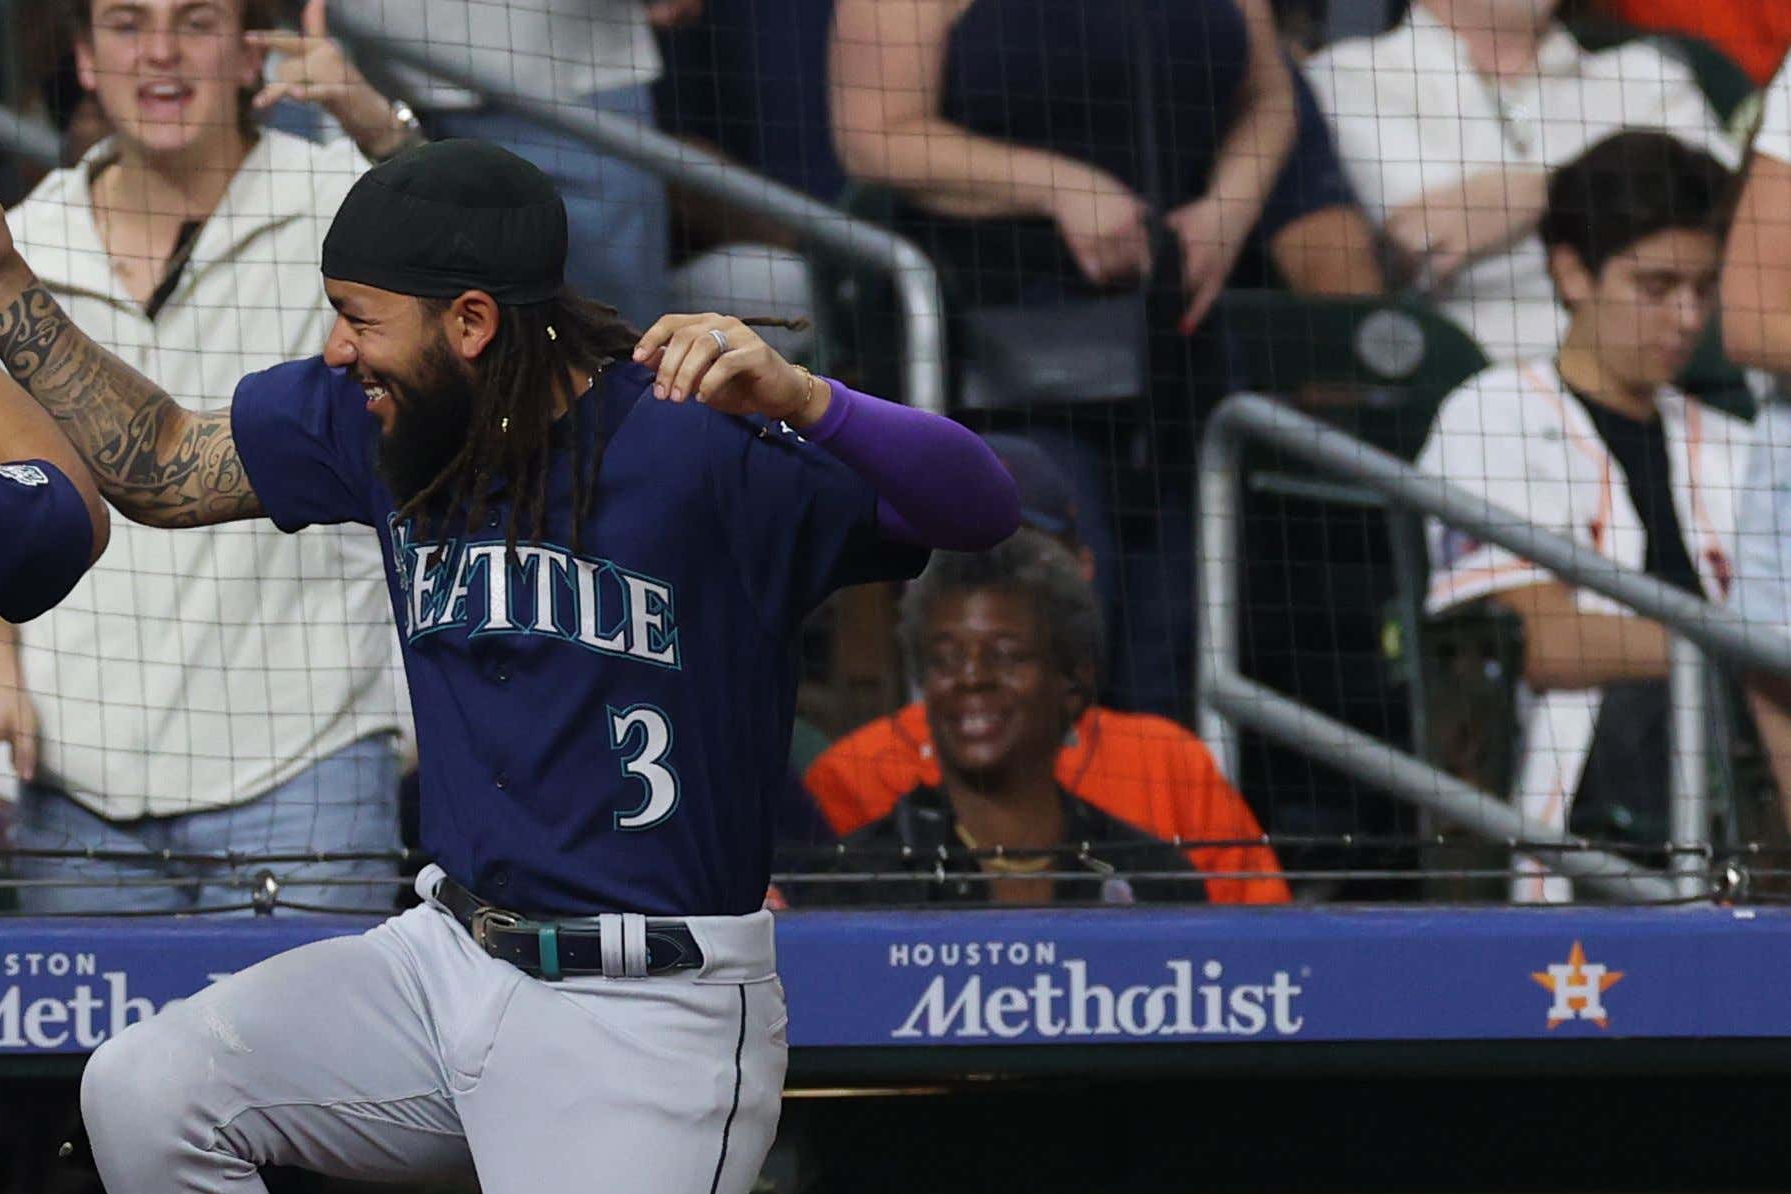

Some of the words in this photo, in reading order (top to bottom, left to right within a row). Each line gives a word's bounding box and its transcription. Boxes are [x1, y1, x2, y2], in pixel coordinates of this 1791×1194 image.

[389, 520, 679, 668] EATTLE
[609, 706, 679, 829] 3
[889, 942, 1056, 967] HOUSTON
[890, 958, 1305, 1038] Methodist
